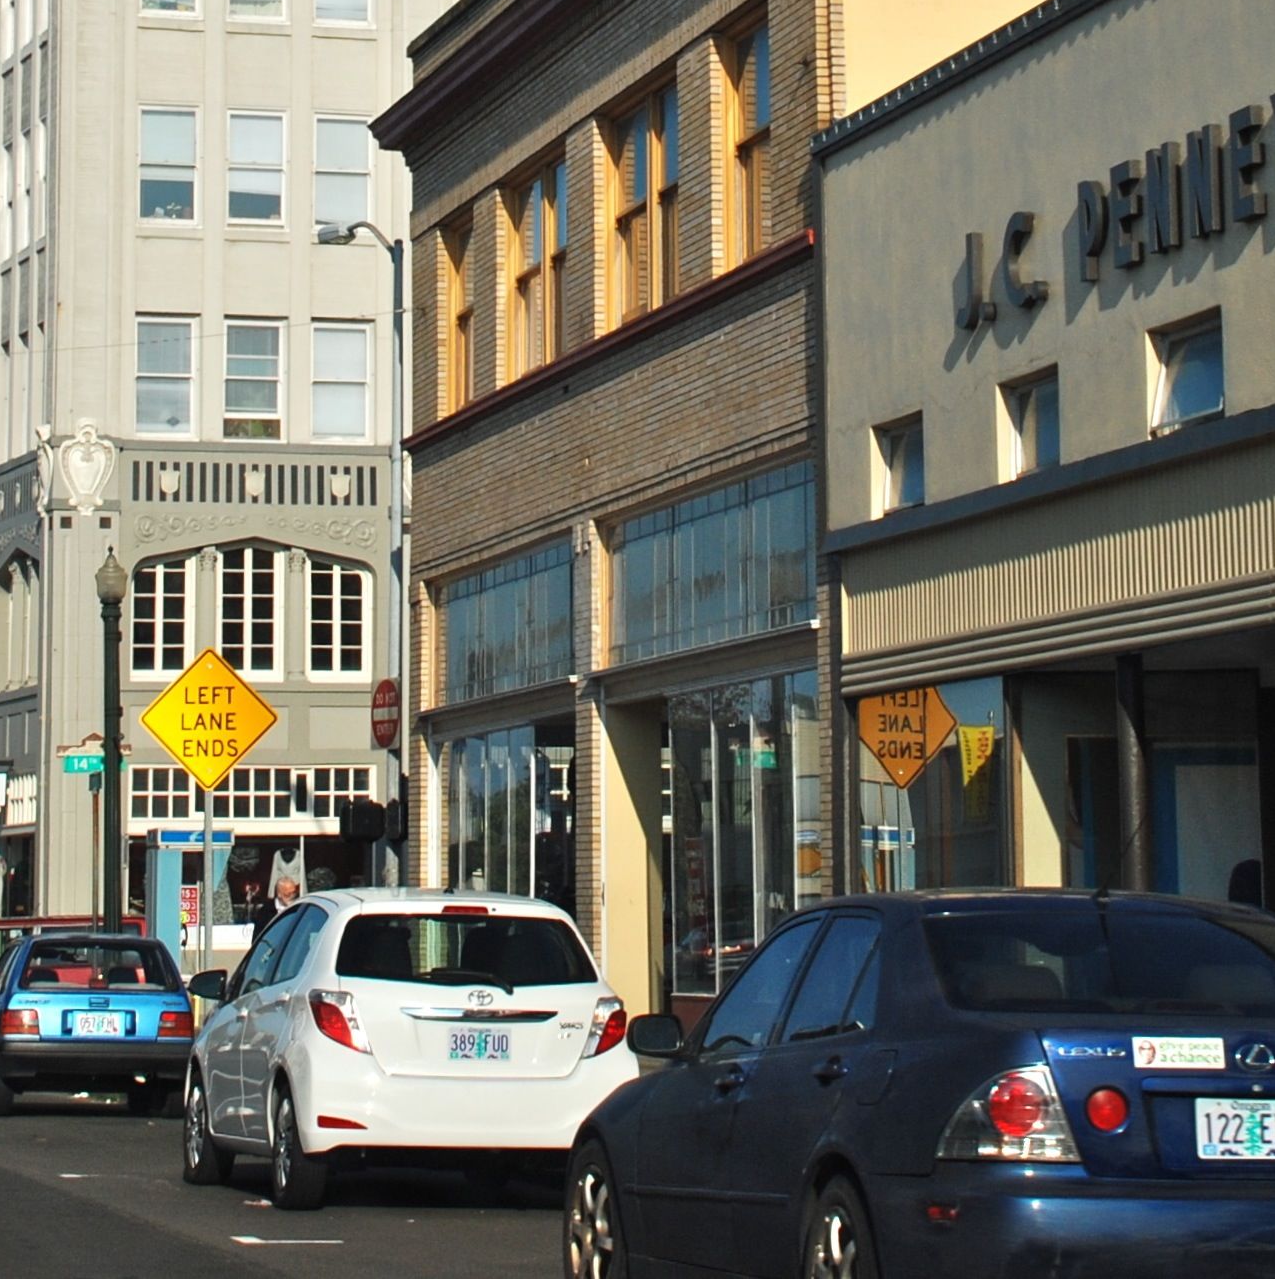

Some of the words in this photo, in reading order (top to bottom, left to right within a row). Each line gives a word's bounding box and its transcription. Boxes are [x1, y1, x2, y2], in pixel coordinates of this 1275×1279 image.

[184, 686, 235, 705] LEFT
[376, 693, 384, 705] DO
[181, 712, 237, 731] LANE
[376, 723, 394, 736] ENTER
[183, 739, 238, 758] ENDS
[450, 1034, 476, 1052] 389
[483, 1034, 509, 1052] FUD
[1159, 1042, 1184, 1051] give
[1189, 1043, 1221, 1052] peace
[1058, 1046, 1126, 1057] LEXUS
[1159, 1054, 1167, 1063] a
[1170, 1052, 1222, 1063] chance
[1204, 1113, 1244, 1144] 122
